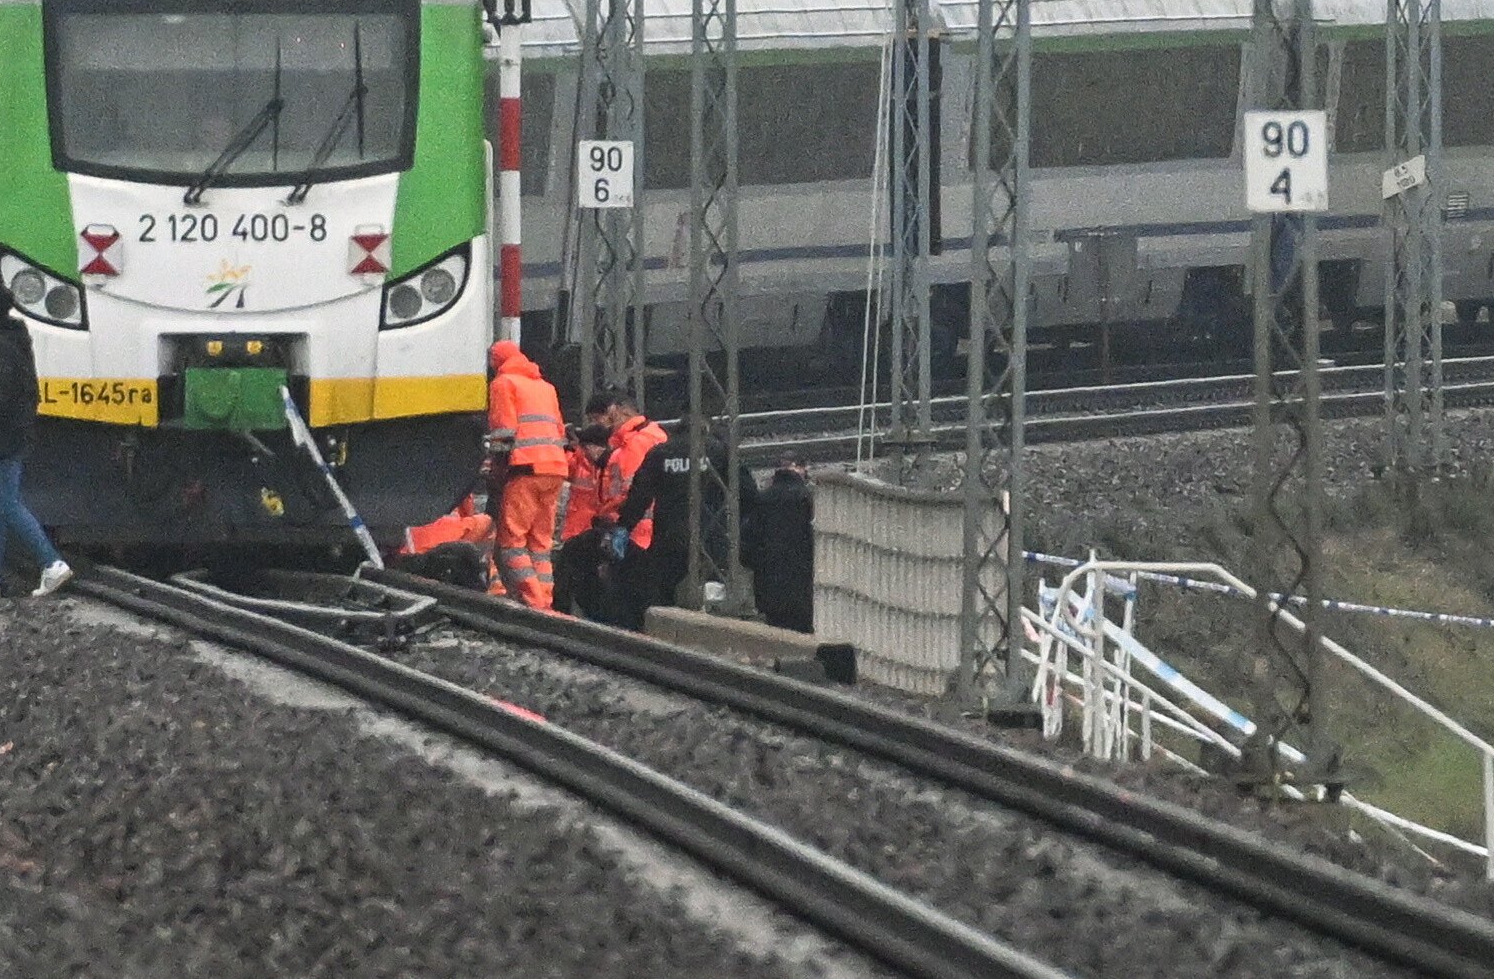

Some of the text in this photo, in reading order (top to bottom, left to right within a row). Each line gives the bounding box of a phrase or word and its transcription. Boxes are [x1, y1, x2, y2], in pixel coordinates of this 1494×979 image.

[1262, 121, 1308, 159] 90
[590, 146, 623, 172] 90
[595, 178, 609, 202] 6
[1270, 168, 1292, 205] 4
[138, 213, 328, 242] 2 120 400-8
[37, 382, 153, 406] L-1645ra
